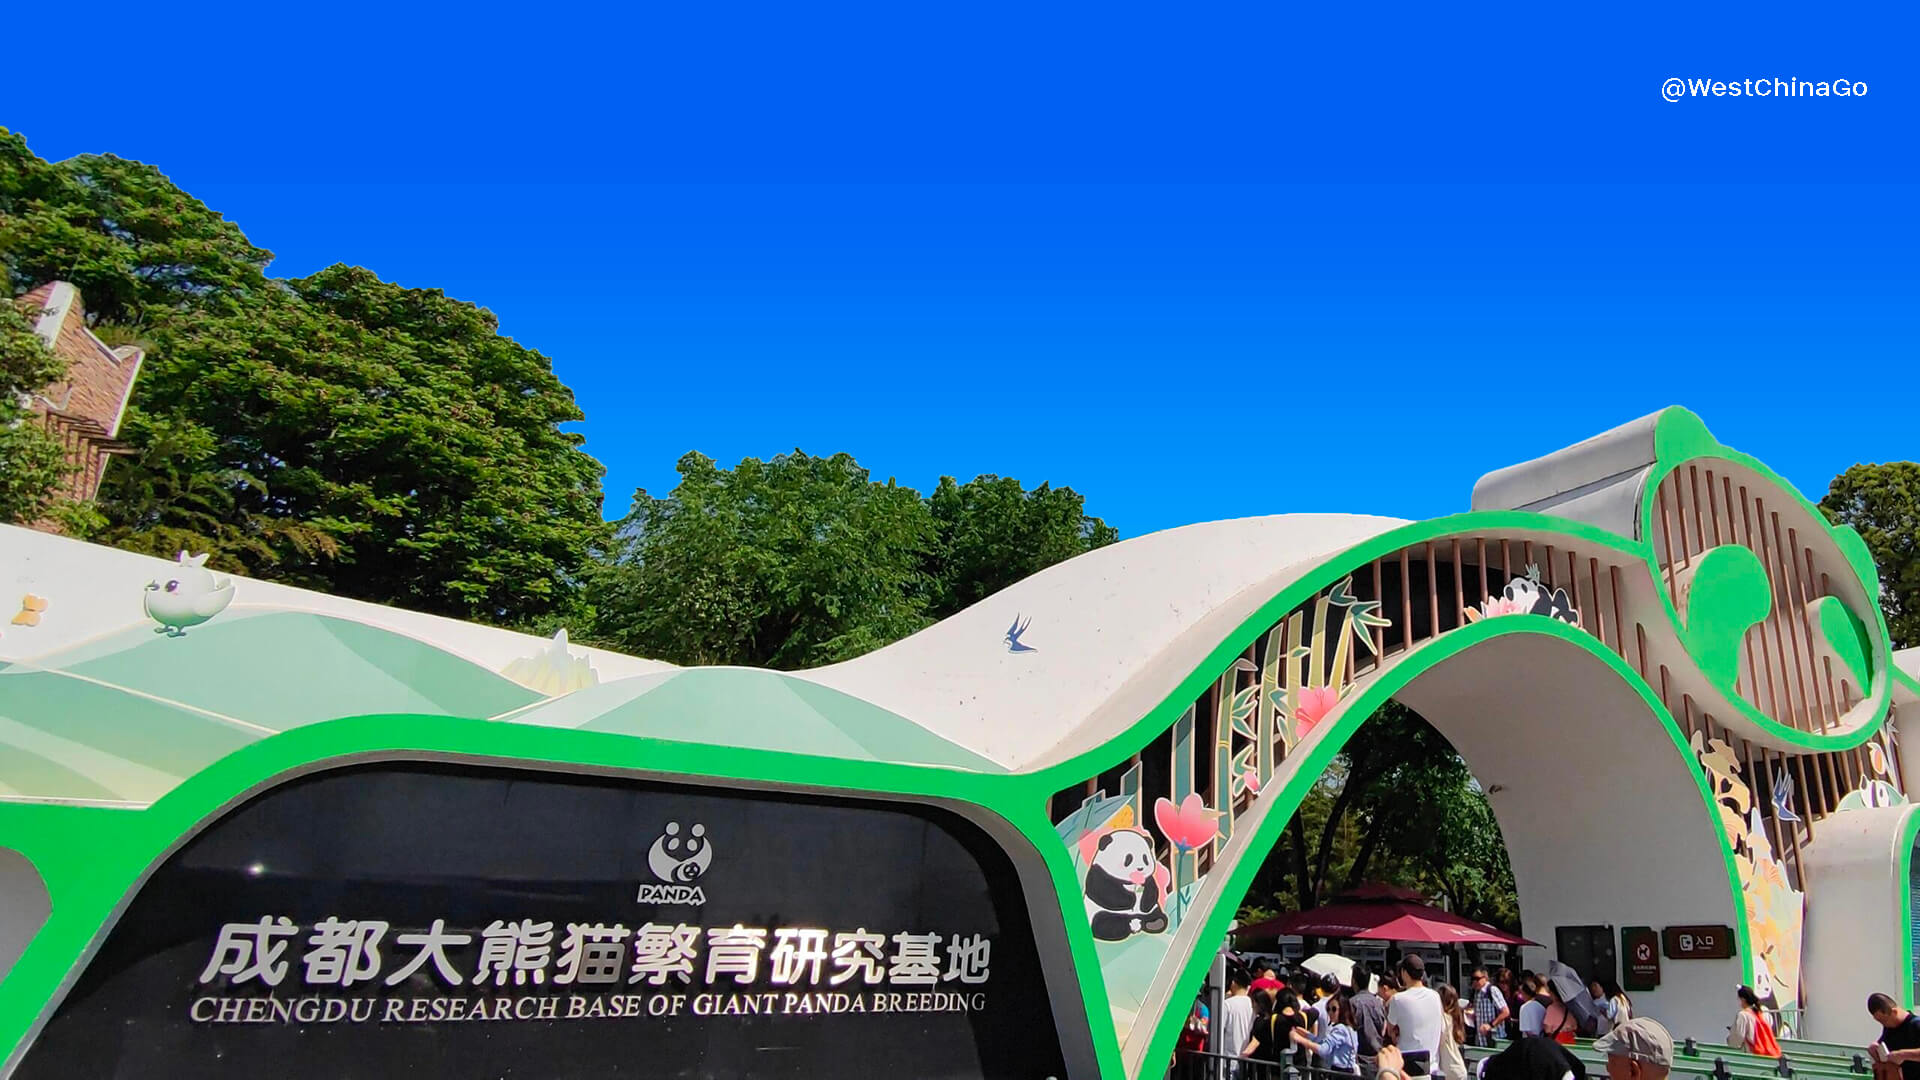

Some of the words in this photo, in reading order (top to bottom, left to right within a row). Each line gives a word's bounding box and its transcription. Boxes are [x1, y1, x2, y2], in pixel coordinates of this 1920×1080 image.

[637, 884, 706, 906] PANDA
[198, 914, 992, 987] 成都大熊猫繁育研究基地
[1696, 935, 1714, 945] 入口
[190, 996, 377, 1023] CHENGDU
[381, 996, 561, 1022] RESEARCH
[567, 994, 642, 1019] BASE
[648, 993, 687, 1017] OF
[692, 993, 779, 1016] GIANT
[781, 992, 867, 1015] PANDA
[873, 992, 986, 1015] BREEDING
